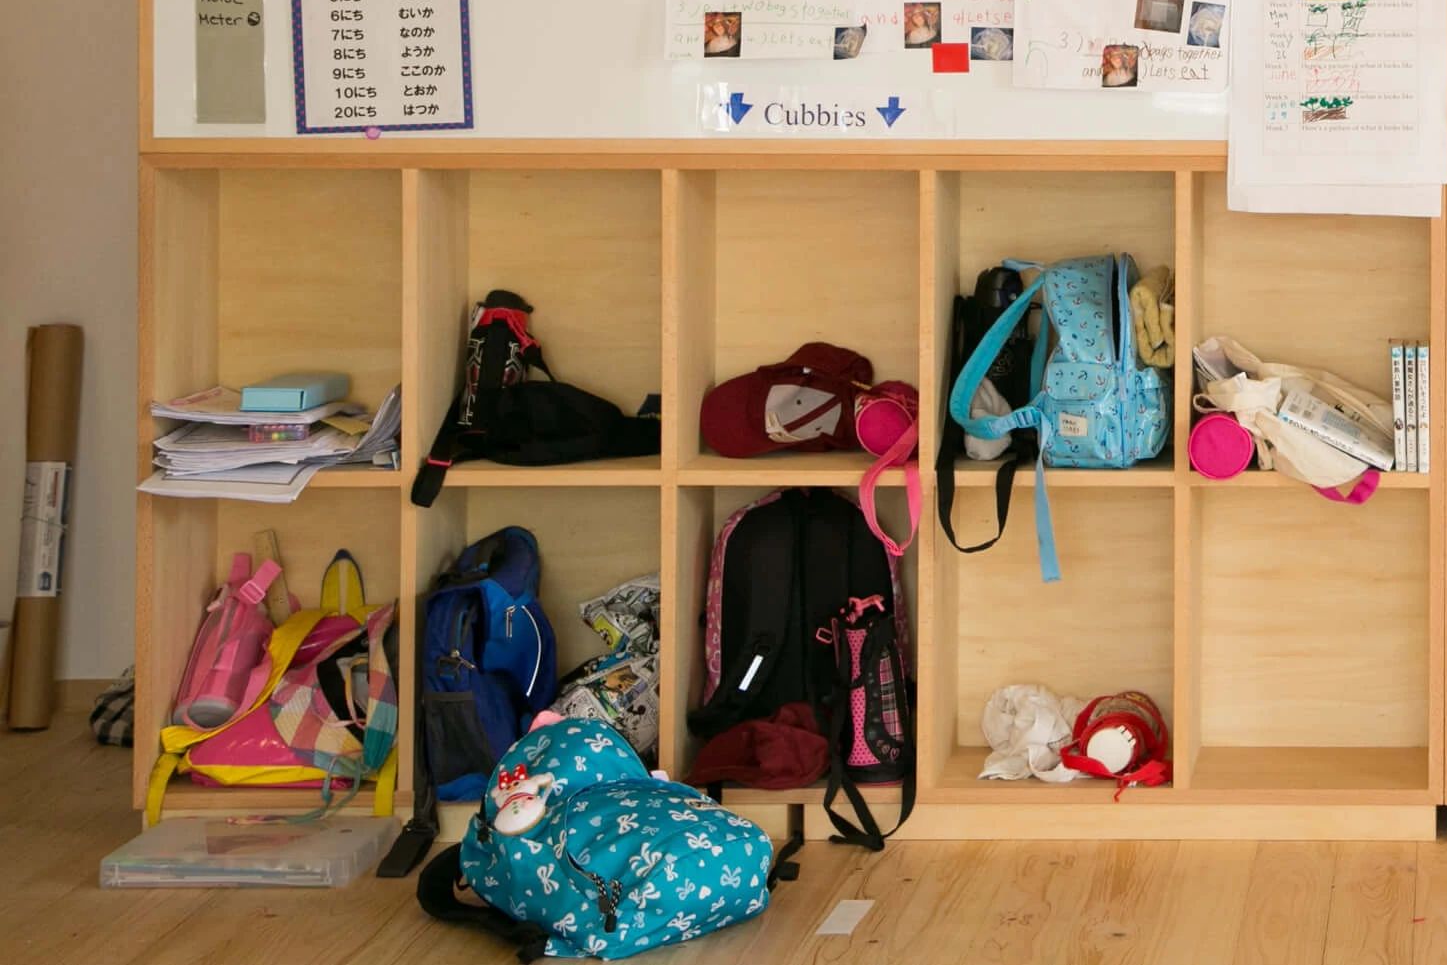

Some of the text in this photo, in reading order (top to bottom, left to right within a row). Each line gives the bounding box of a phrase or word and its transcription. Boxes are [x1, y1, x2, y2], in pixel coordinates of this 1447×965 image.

[198, 12, 245, 27] Meter
[330, 7, 434, 22] 6にち むいか
[331, 26, 436, 41] 7にち なのか
[333, 45, 435, 60] 8にち ようか
[332, 64, 446, 80] 9にち ここのか
[335, 84, 438, 99] 10にち とおか
[334, 104, 440, 119] 20にち はつか
[764, 101, 866, 127] Cubbies
